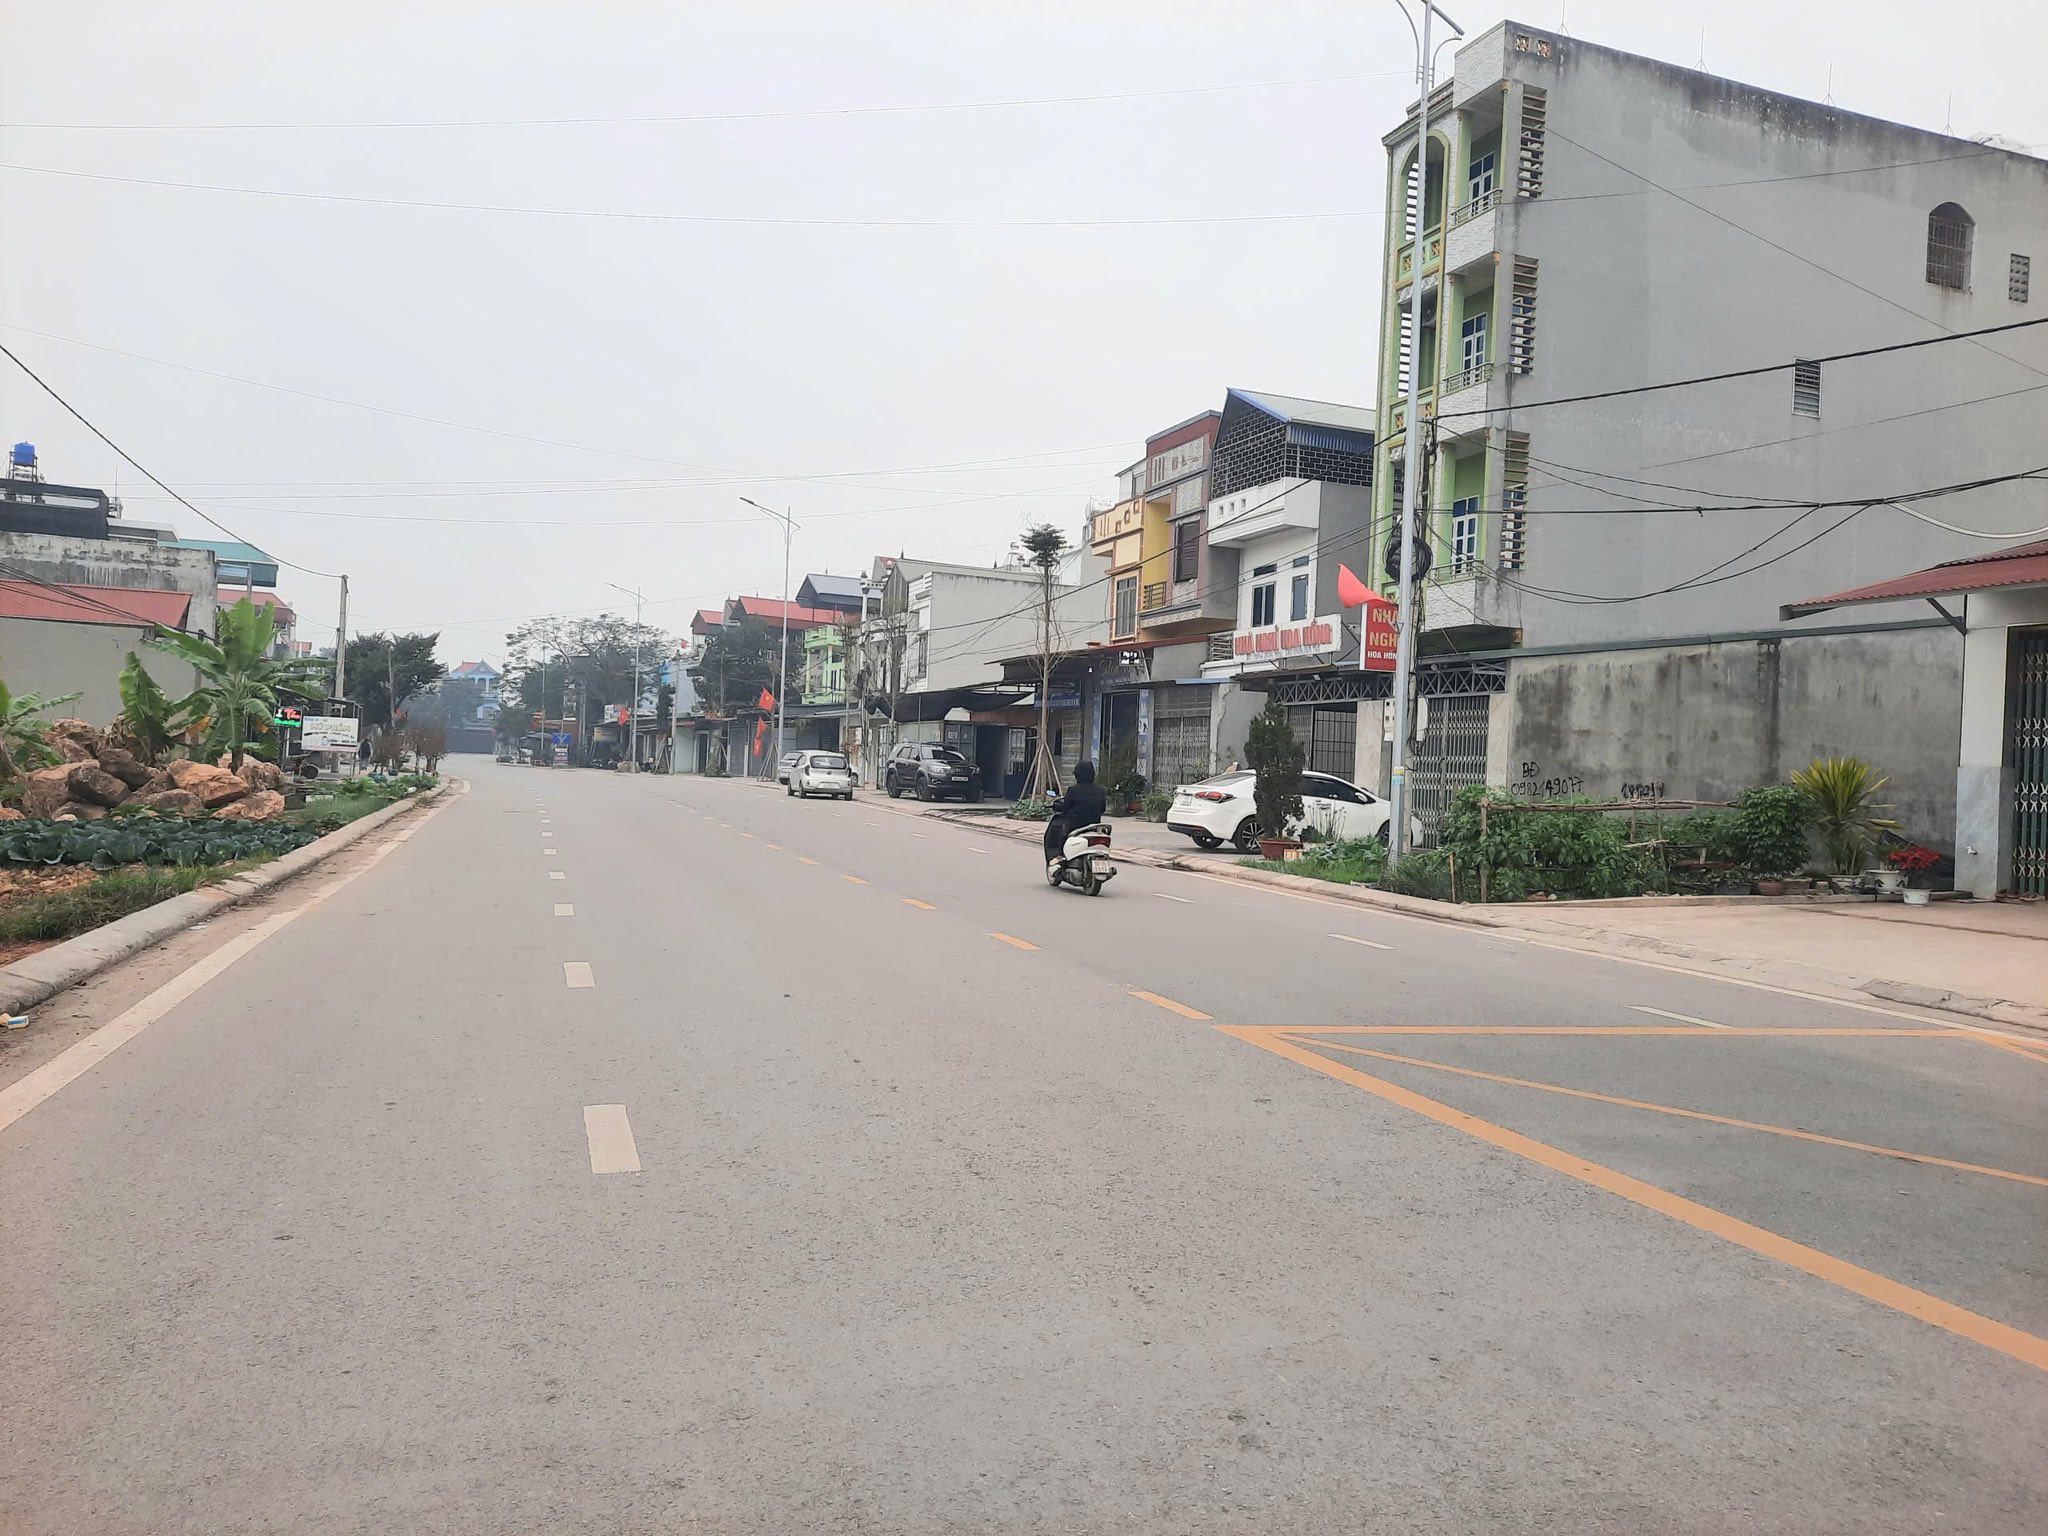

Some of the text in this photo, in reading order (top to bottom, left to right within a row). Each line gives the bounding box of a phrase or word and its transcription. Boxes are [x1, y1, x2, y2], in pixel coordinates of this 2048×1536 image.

[1370, 632, 1397, 648] NGH
[1367, 650, 1397, 660] HOA HỒN
